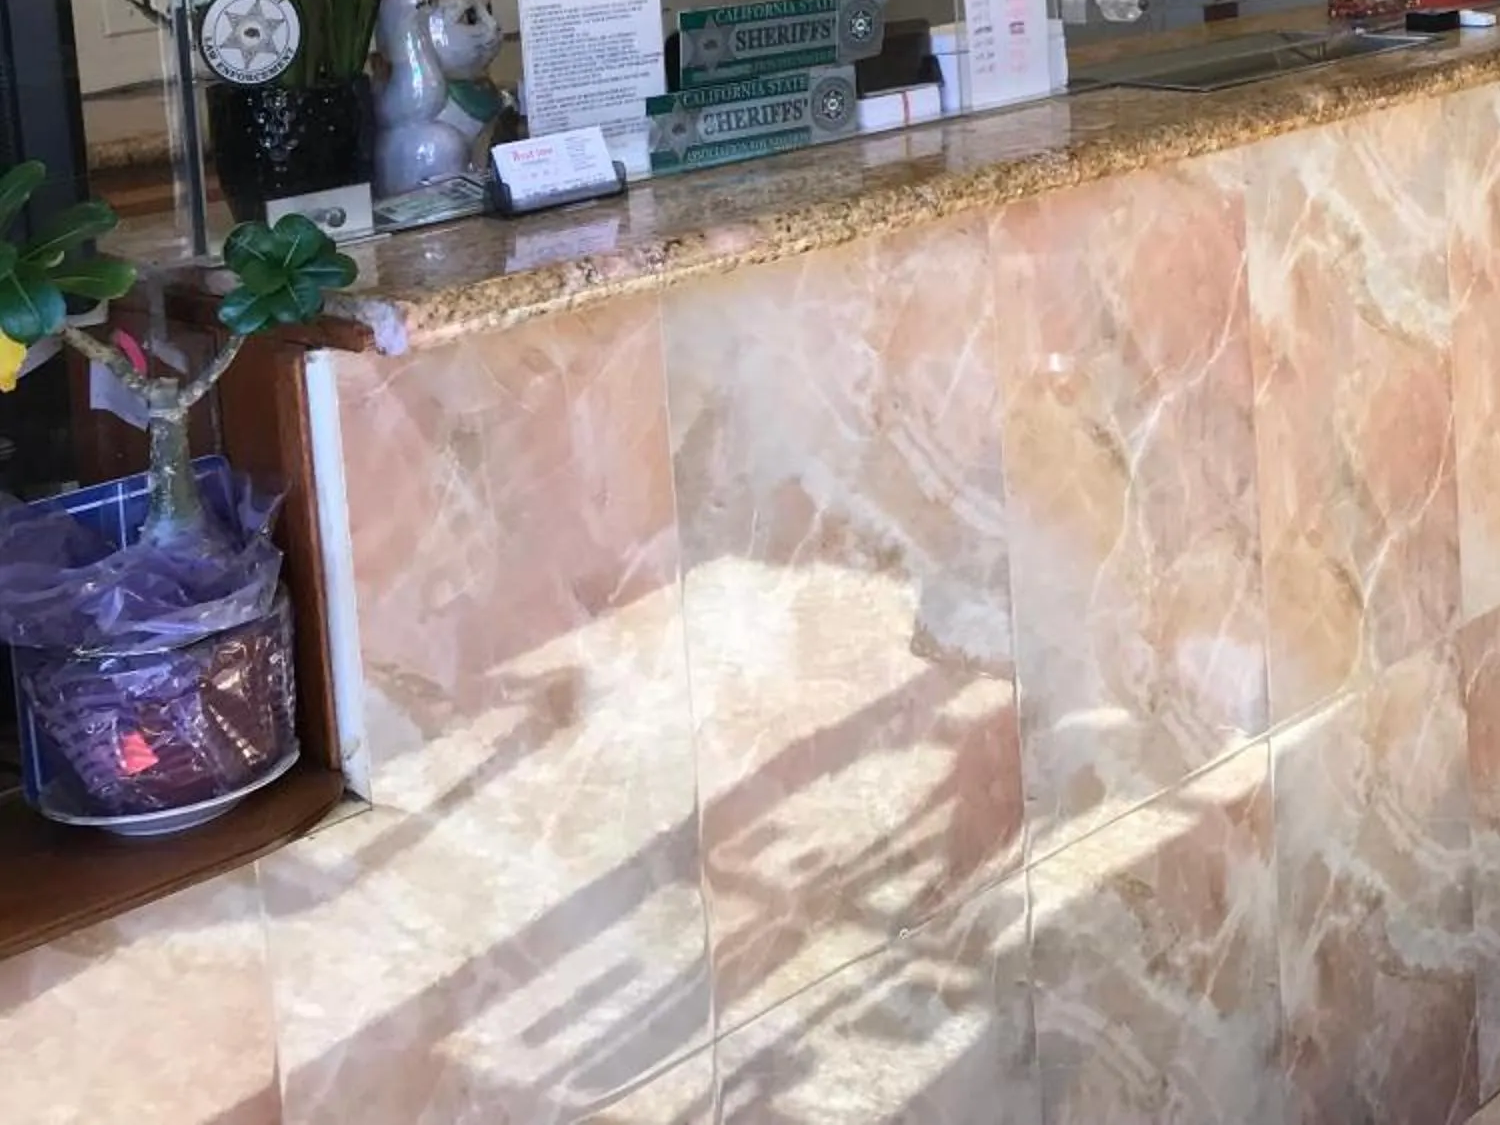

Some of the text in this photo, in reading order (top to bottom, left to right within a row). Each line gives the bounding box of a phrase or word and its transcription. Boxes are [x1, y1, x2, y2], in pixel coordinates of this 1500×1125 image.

[203, 37, 294, 82] LAW ENFORCEMENT
[683, 75, 808, 106] CALIFORNIA STATE
